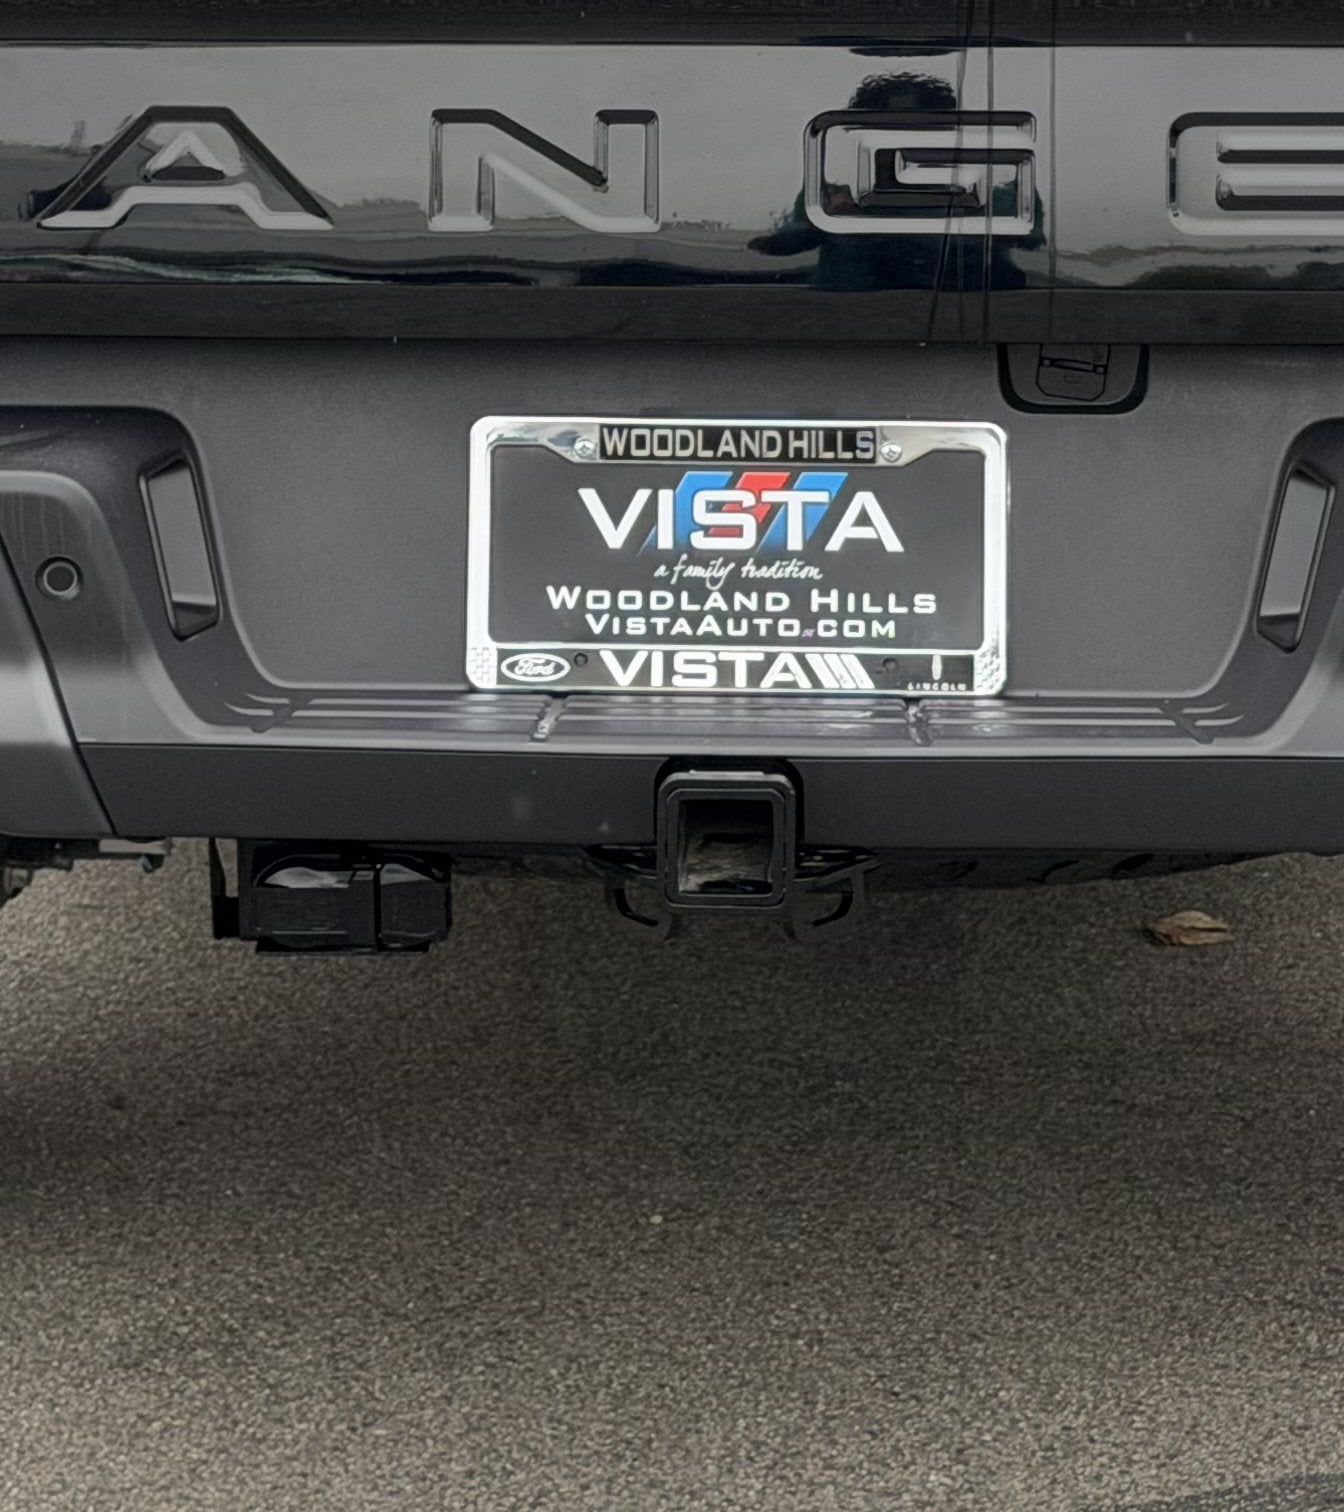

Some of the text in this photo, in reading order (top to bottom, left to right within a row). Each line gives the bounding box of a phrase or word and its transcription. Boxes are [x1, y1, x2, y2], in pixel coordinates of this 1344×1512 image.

[602, 428, 875, 460] WOODLAND HILLS
[578, 488, 904, 553] VISTA
[654, 553, 823, 589] a family tradition
[546, 586, 937, 614] WOODLAND HILLS
[514, 657, 557, 676] Ford
[599, 650, 812, 689] VISTA
